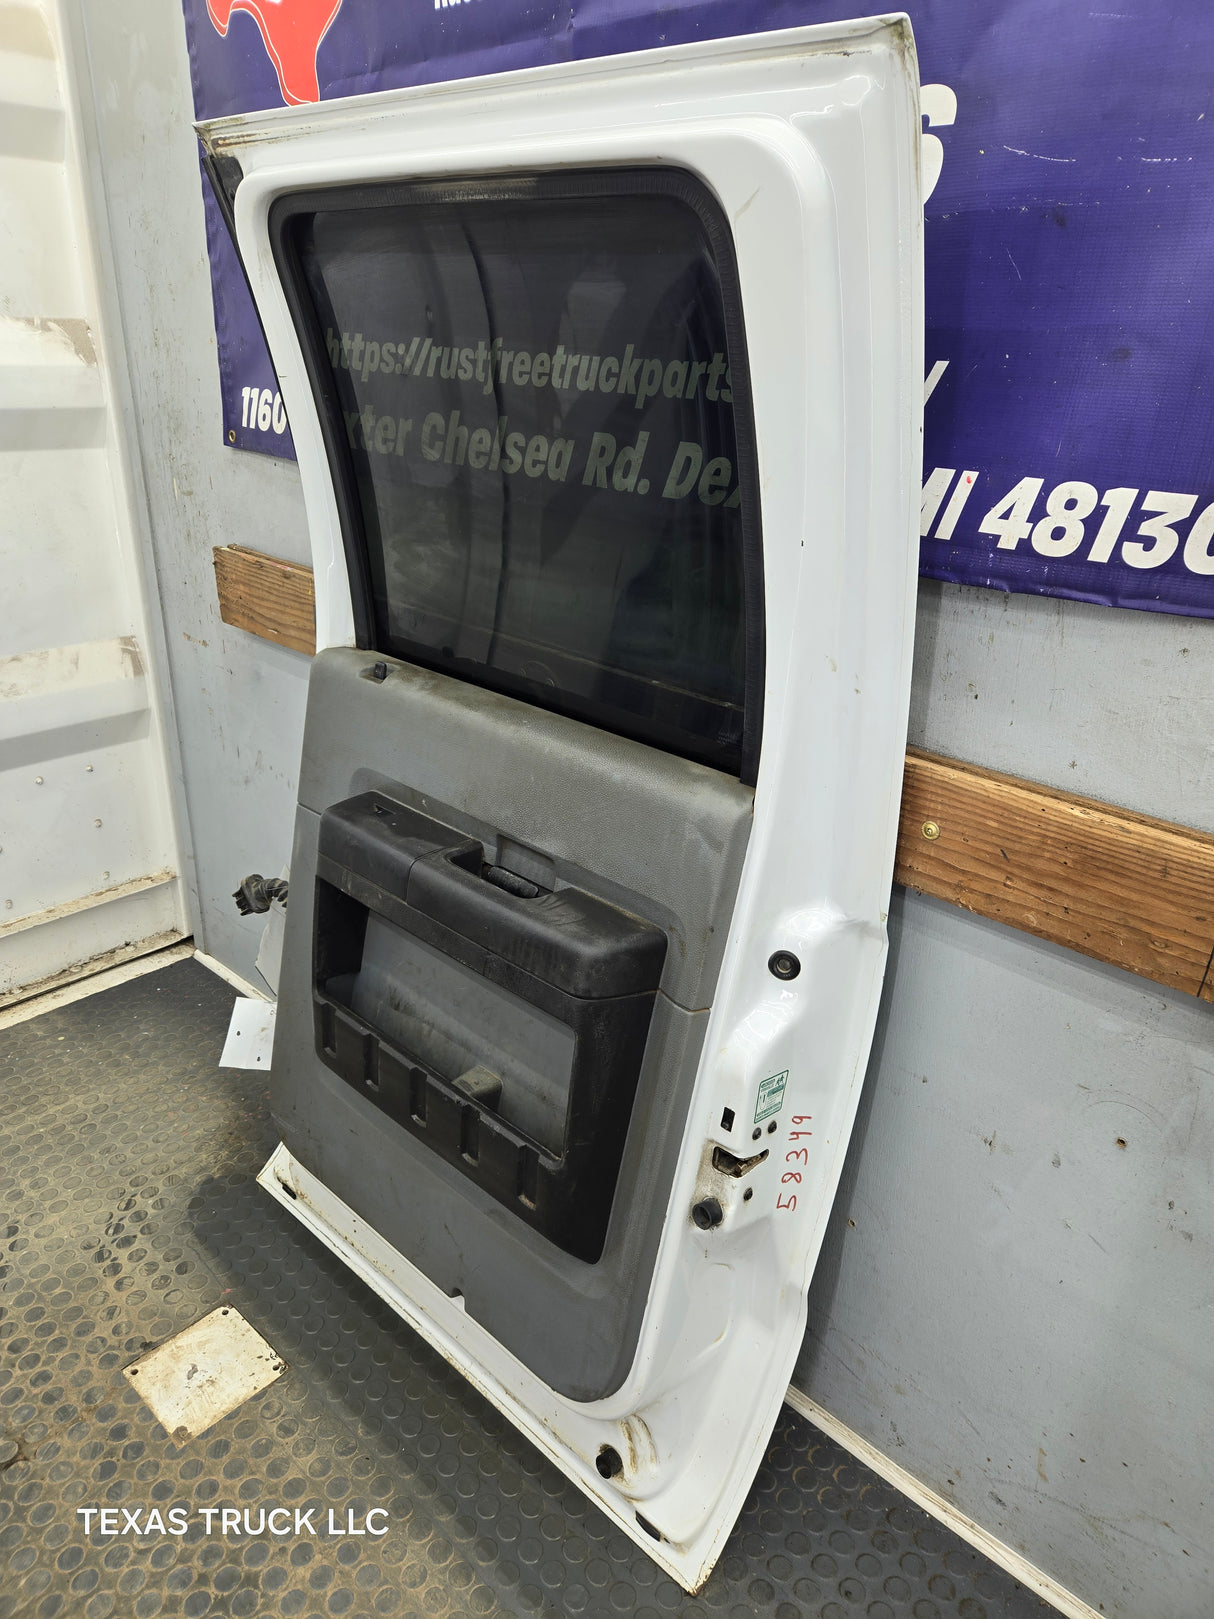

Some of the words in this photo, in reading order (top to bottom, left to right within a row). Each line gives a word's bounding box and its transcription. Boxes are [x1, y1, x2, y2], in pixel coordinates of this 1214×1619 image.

[420, 410, 575, 482] Chelsea
[582, 430, 651, 495] Rd.
[661, 441, 741, 509] De
[776, 1115, 812, 1212] 58349
